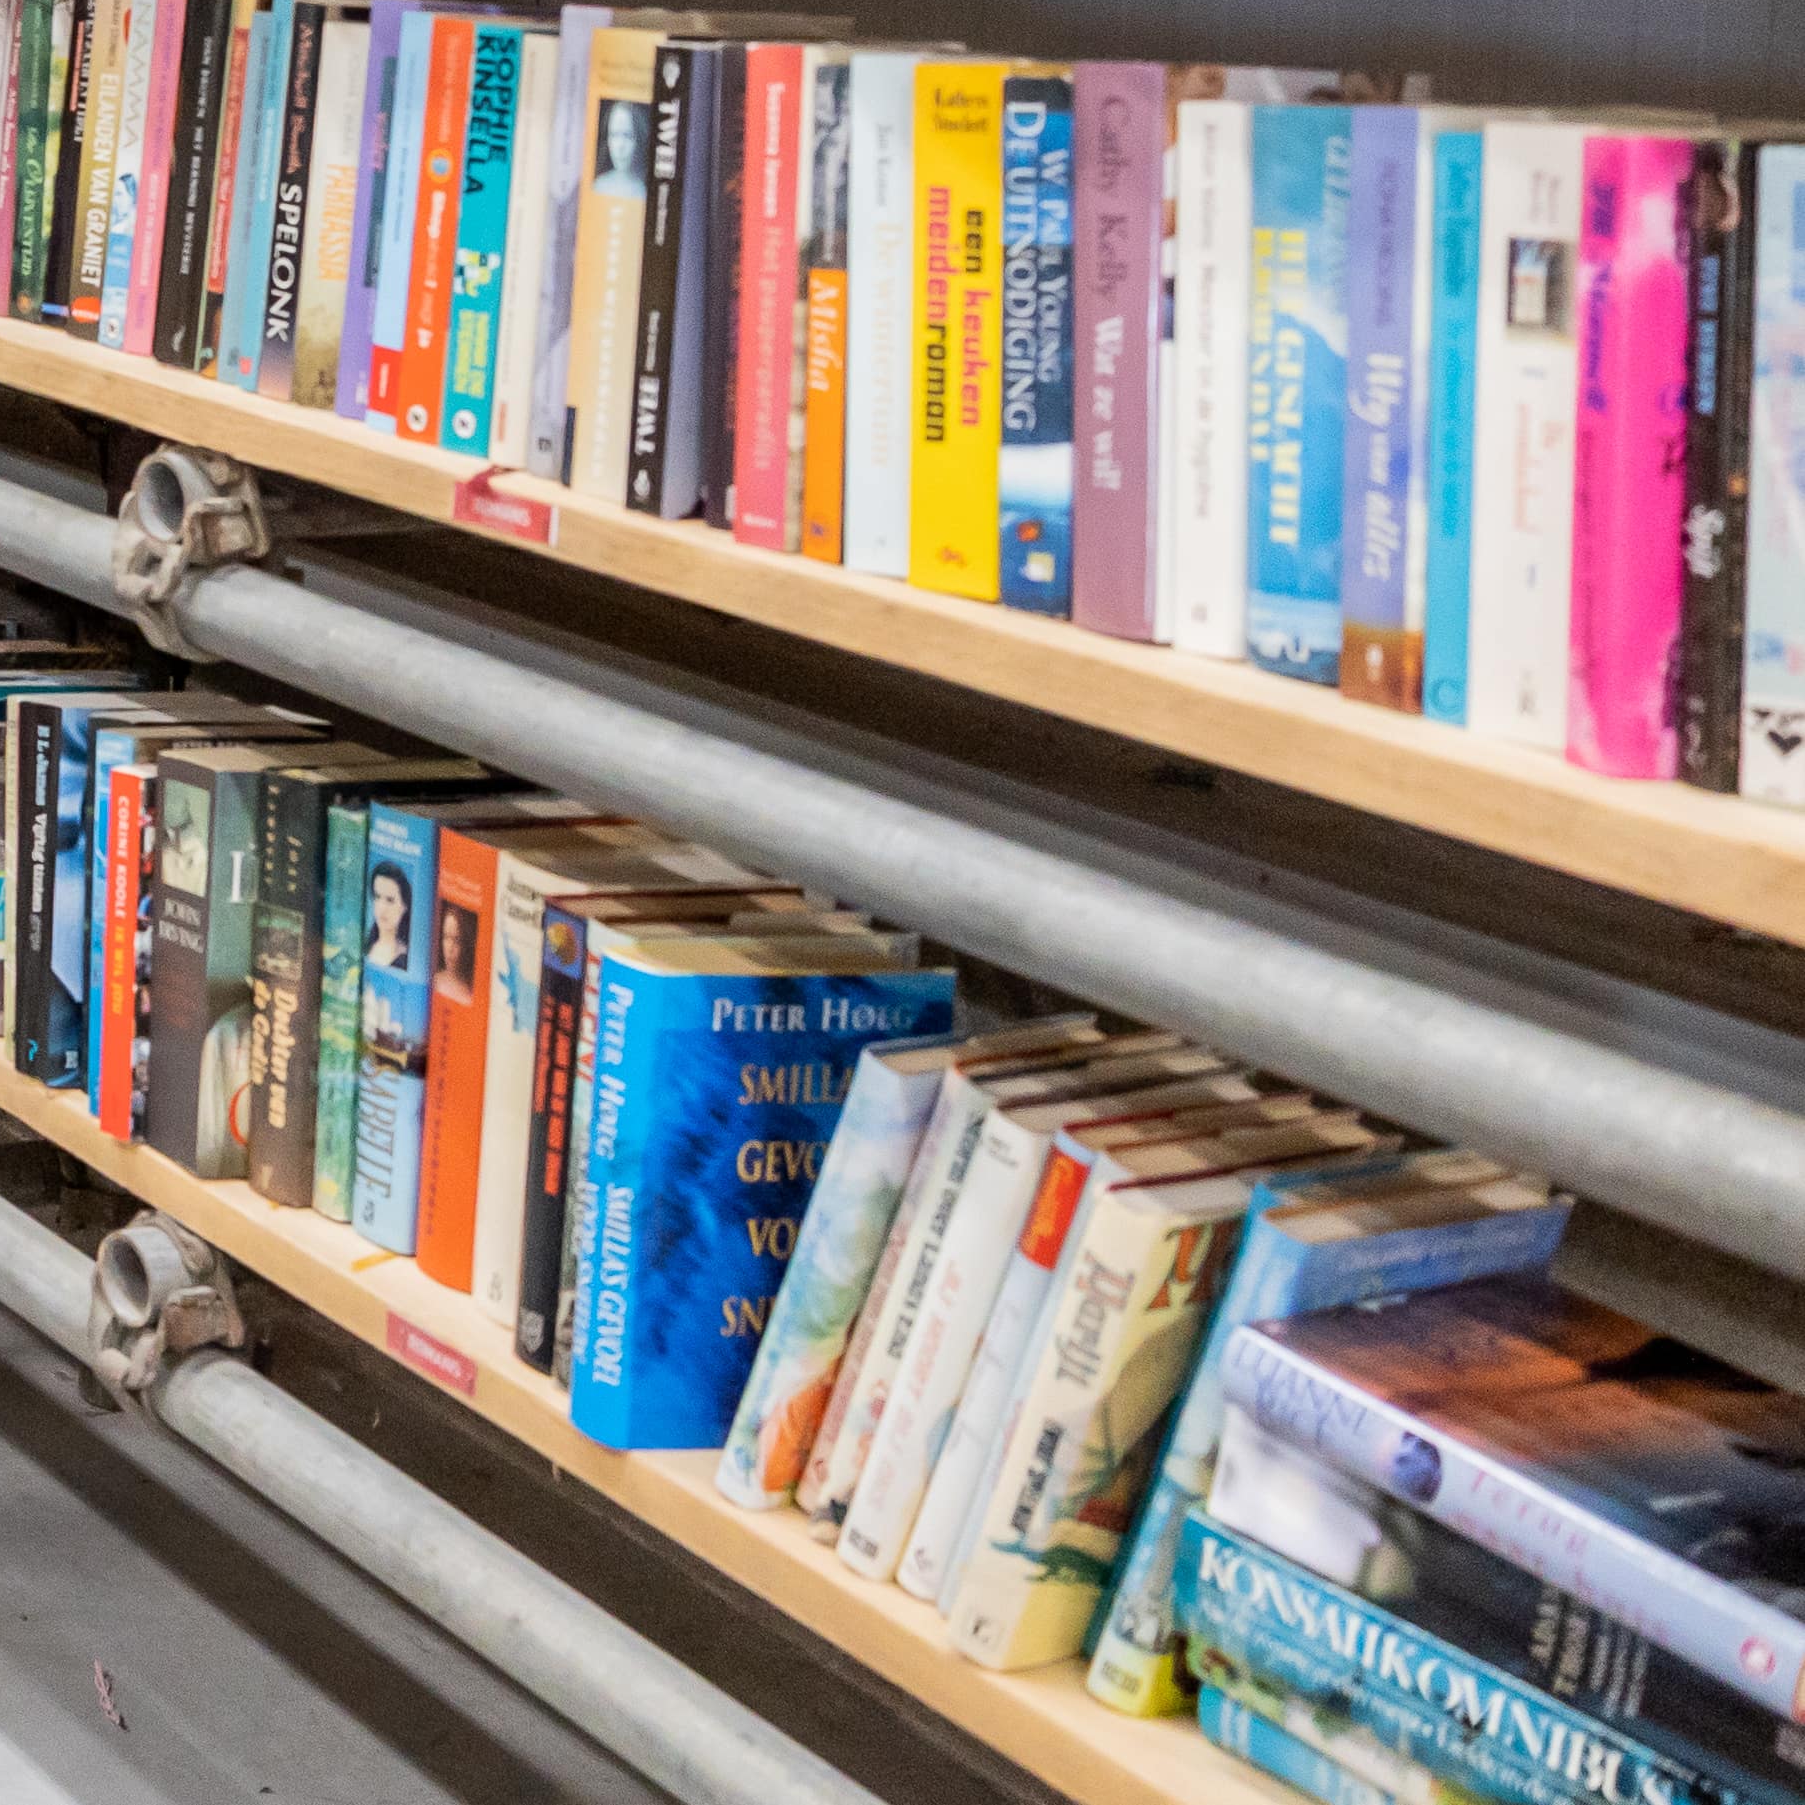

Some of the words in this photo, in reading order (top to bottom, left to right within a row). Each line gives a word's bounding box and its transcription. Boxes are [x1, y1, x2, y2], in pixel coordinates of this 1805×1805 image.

[92, 73, 118, 164] EILANDEN
[462, 34, 495, 195] KINSELLA
[490, 35, 518, 165] SOPHIE
[653, 100, 680, 179] TWEE
[1004, 100, 1045, 161] DE
[87, 167, 110, 205] VAN
[318, 163, 359, 282] PARNASSIA
[79, 209, 106, 287] GRANIET
[265, 181, 303, 342] SPELONK
[965, 209, 987, 274] een
[807, 277, 840, 391] Misha
[925, 185, 957, 443] meidenroman
[1004, 166, 1041, 432] UITNODIGING
[960, 289, 991, 426] keuken
[115, 796, 131, 859] CORINE
[113, 864, 128, 918] KOOLE
[112, 947, 126, 978] WIL
[113, 926, 126, 942] IK
[111, 982, 125, 1015] JOU
[601, 982, 635, 1066] PETER
[711, 997, 806, 1033] PETER
[355, 1045, 411, 1197] ISABELLE
[590, 1291, 630, 1388] GEVOEL
